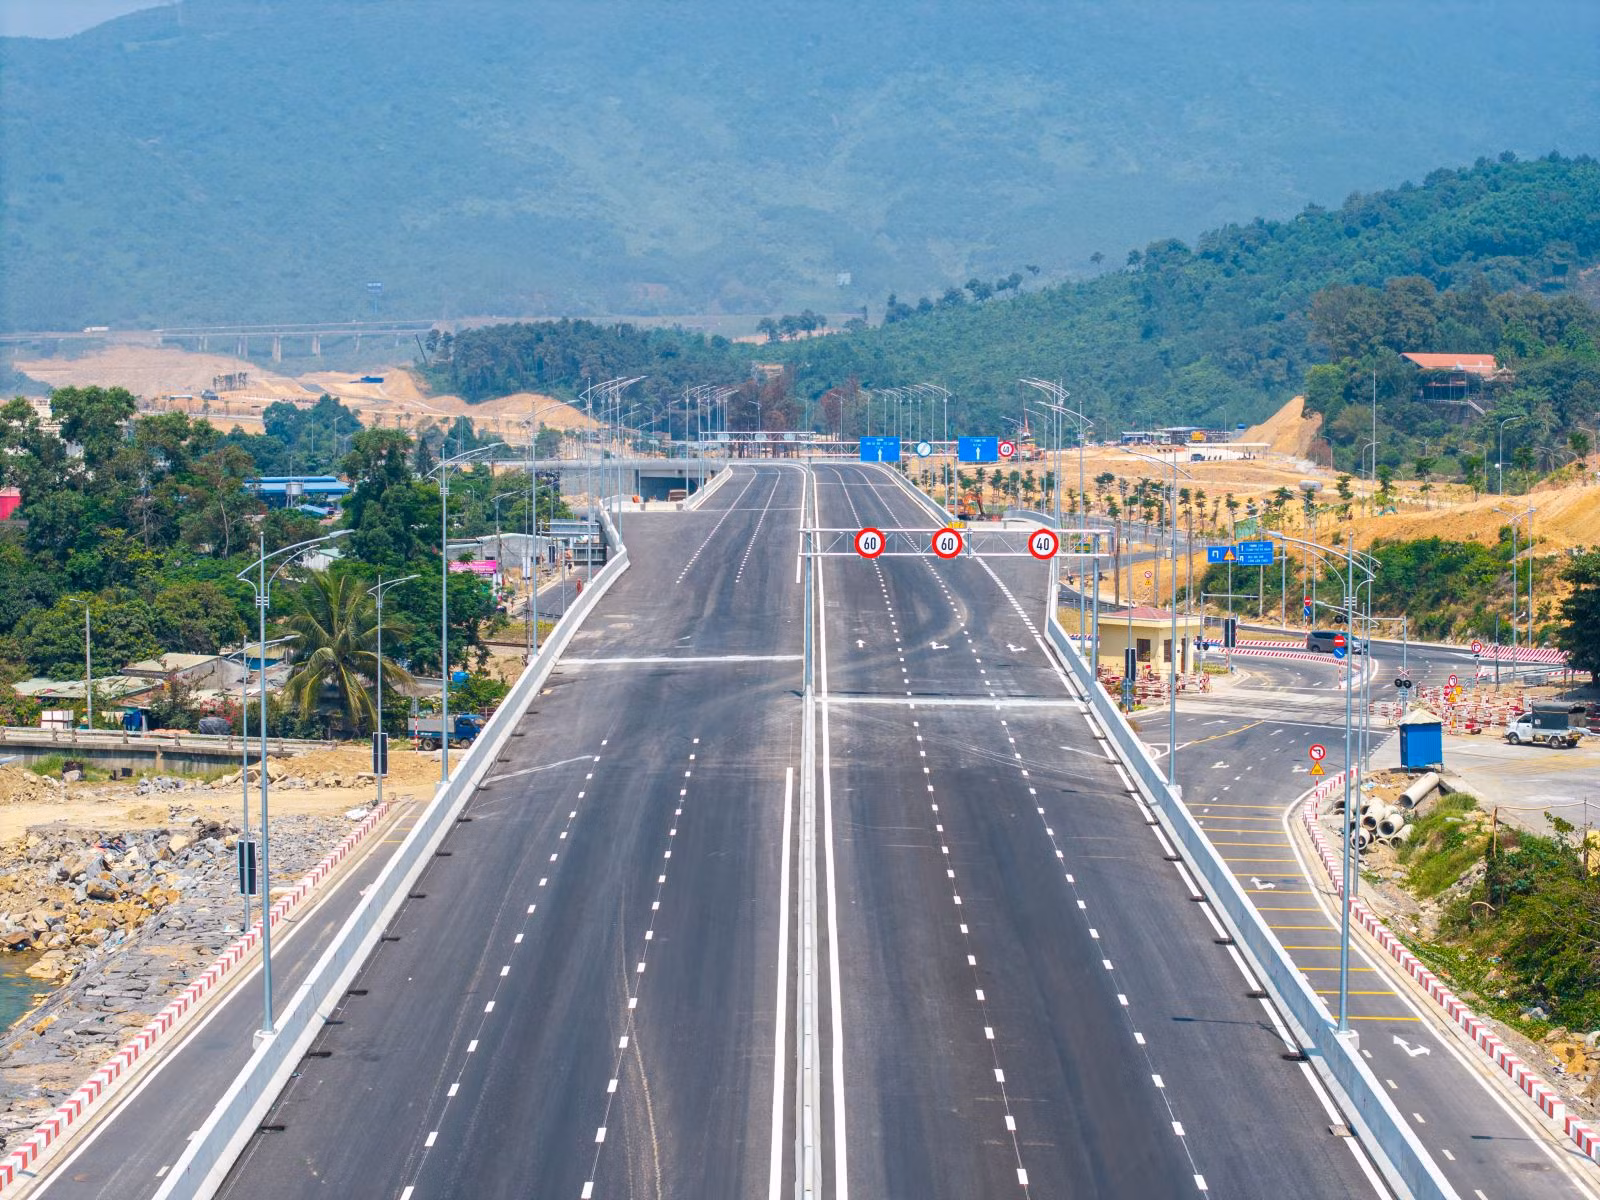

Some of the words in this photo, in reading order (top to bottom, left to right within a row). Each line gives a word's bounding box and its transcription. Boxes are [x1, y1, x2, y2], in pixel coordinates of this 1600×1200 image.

[863, 537, 876, 550] 60
[941, 538, 954, 550] 60
[1036, 538, 1049, 550] 40
